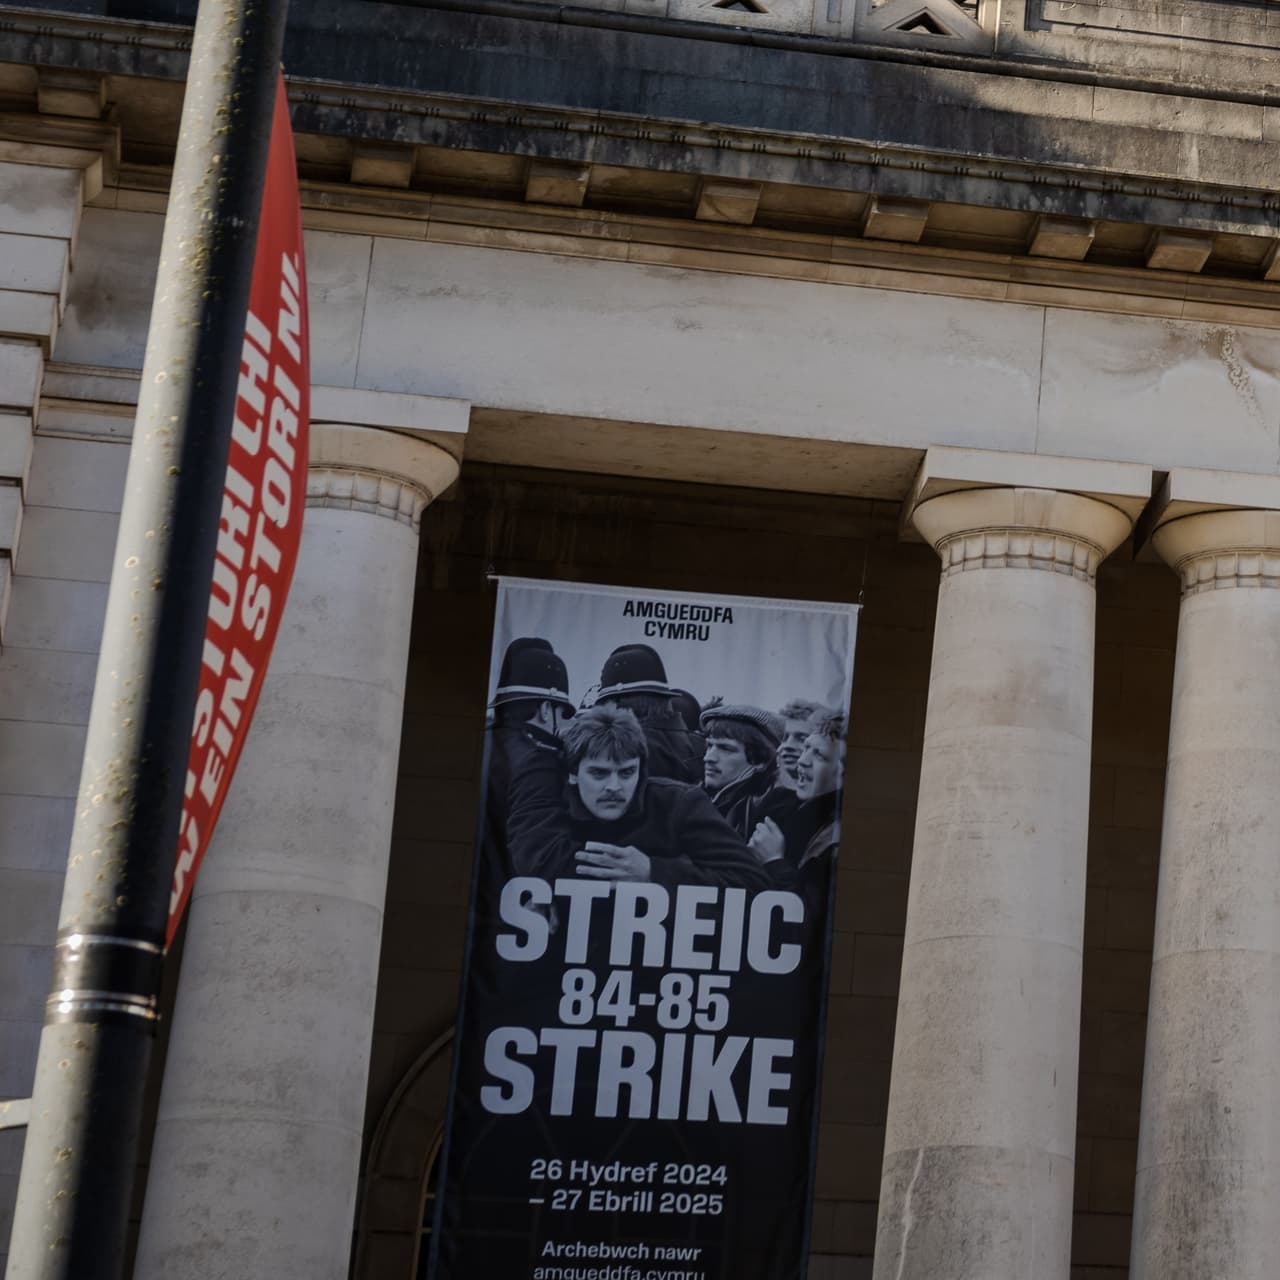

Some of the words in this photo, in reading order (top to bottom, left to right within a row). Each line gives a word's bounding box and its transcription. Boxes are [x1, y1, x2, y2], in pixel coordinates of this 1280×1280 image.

[200, 647, 254, 808] EIN
[242, 364, 300, 641] STORI
[623, 600, 733, 624] AMGUEDDFA
[644, 620, 710, 641] CYMRU
[496, 876, 805, 974] STREIC
[558, 968, 731, 1032] 84-85
[480, 1026, 795, 1125] STRIKE
[530, 1158, 563, 1180] 26
[569, 1160, 658, 1186] Hydref
[663, 1163, 727, 1186] 2024
[551, 1189, 582, 1210] 27
[588, 1190, 653, 1212] Ebrill
[659, 1192, 724, 1215] 2025
[541, 1240, 649, 1259] Archebwch
[654, 1246, 702, 1261] nawr
